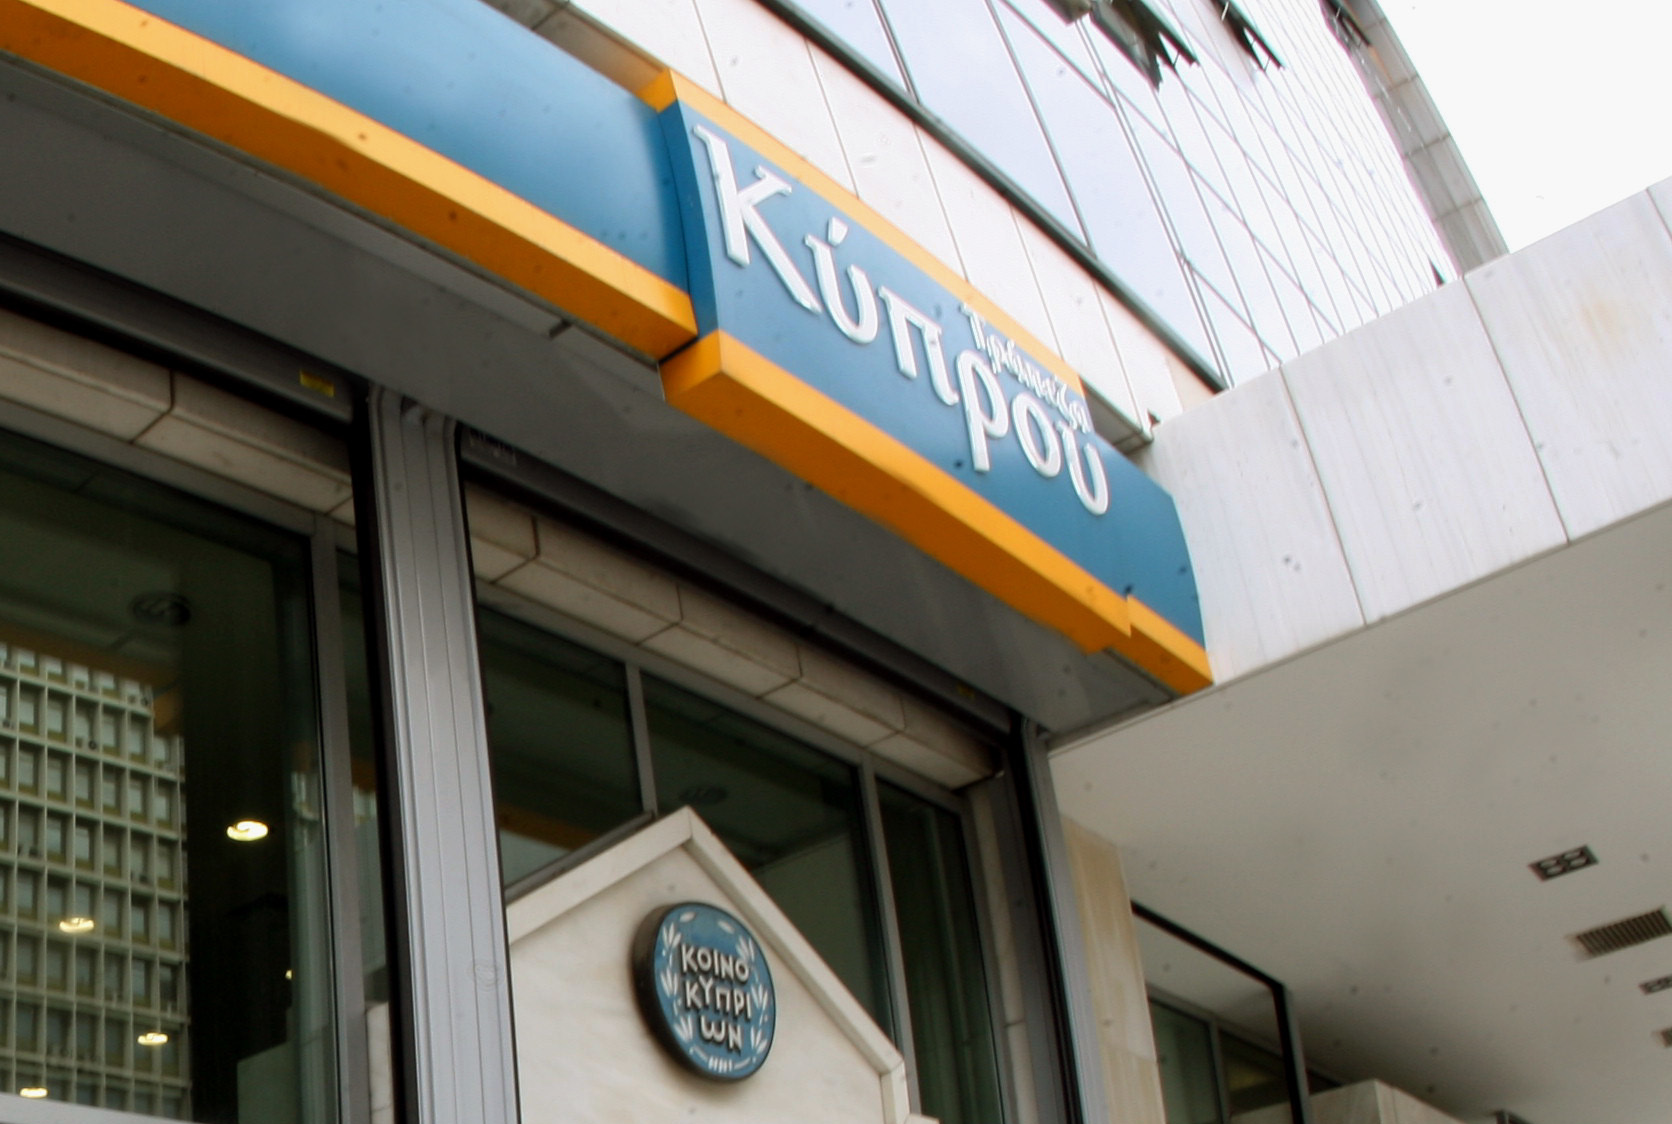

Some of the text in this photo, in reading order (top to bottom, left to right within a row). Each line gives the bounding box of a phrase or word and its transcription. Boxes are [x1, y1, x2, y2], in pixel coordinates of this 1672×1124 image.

[693, 124, 1110, 516] Κύπρου
[681, 943, 750, 982] ΚΟΙΝΟ
[685, 976, 752, 1019] ΚΥΠΡΙ
